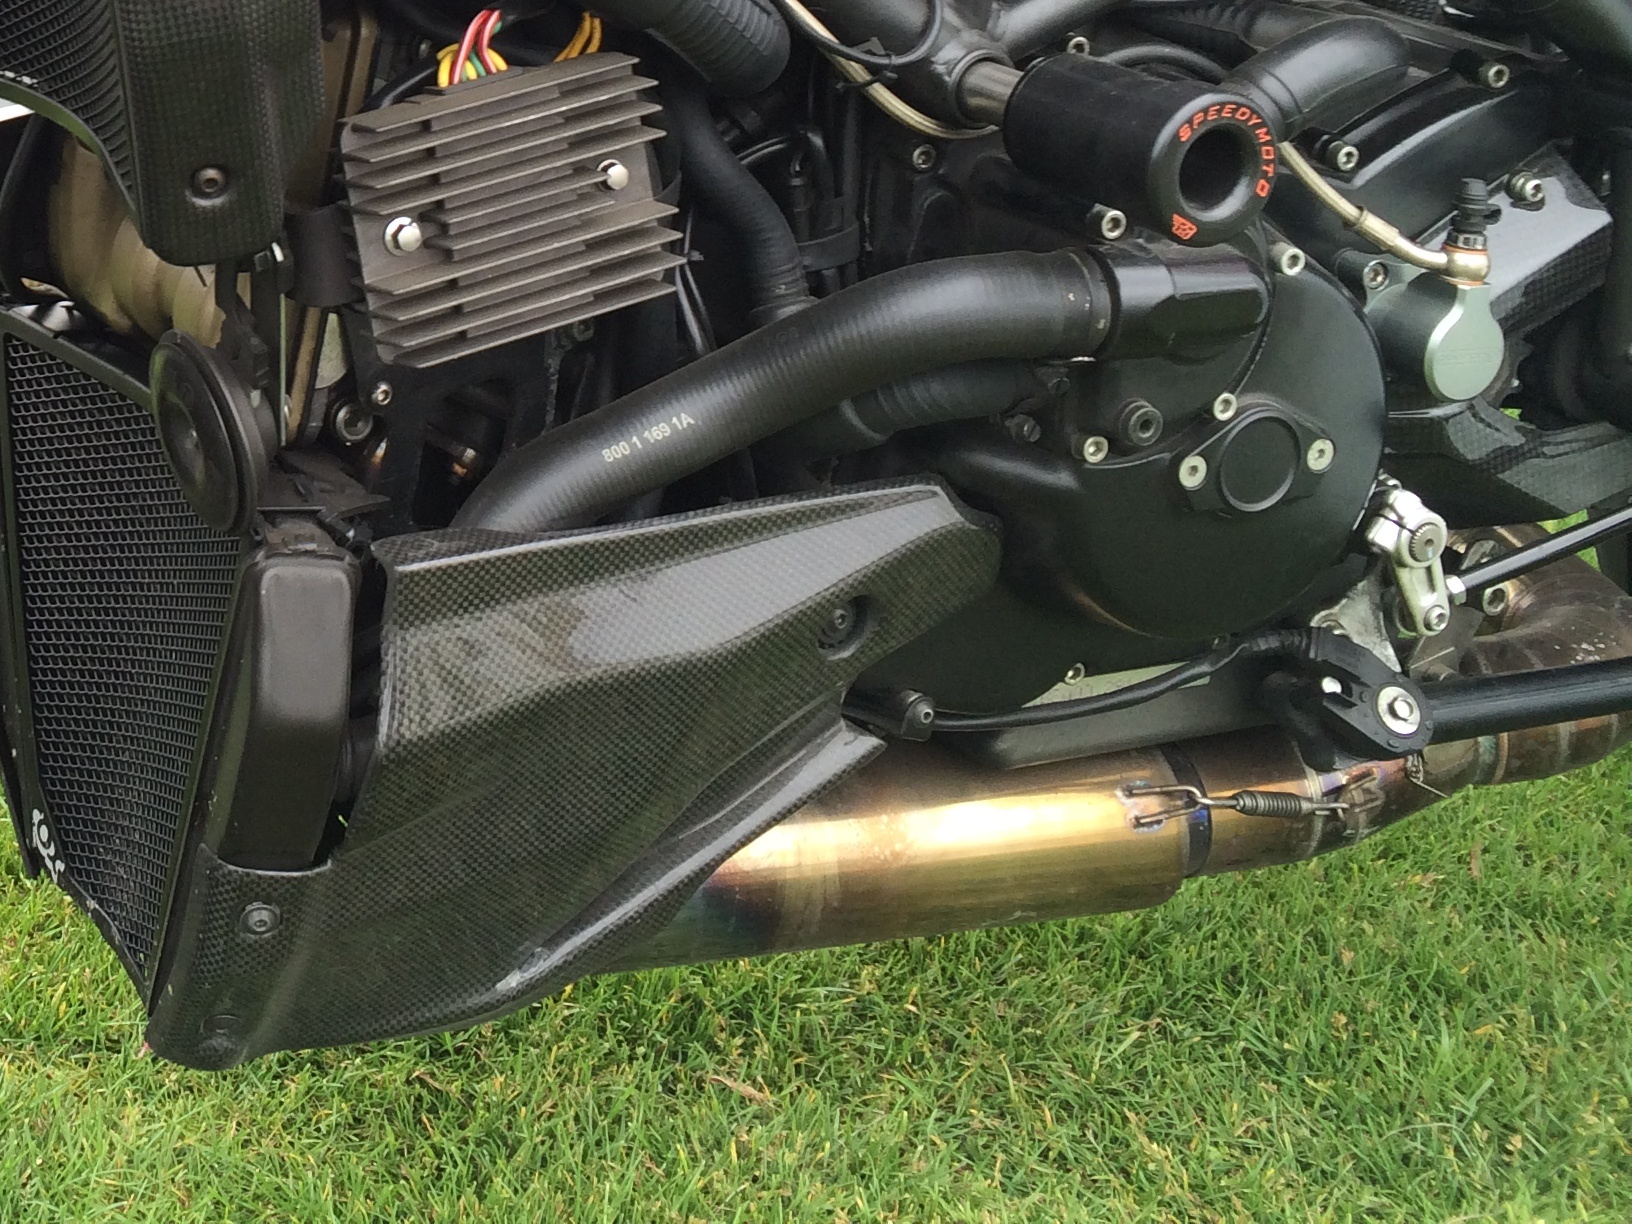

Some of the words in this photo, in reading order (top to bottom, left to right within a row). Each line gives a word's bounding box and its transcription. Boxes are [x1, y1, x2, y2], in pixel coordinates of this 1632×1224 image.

[1178, 104, 1276, 198] SPEEDYMOTO
[601, 441, 631, 463] 800
[631, 435, 643, 449] 1
[643, 422, 671, 443] 169
[671, 412, 696, 430] 1A
